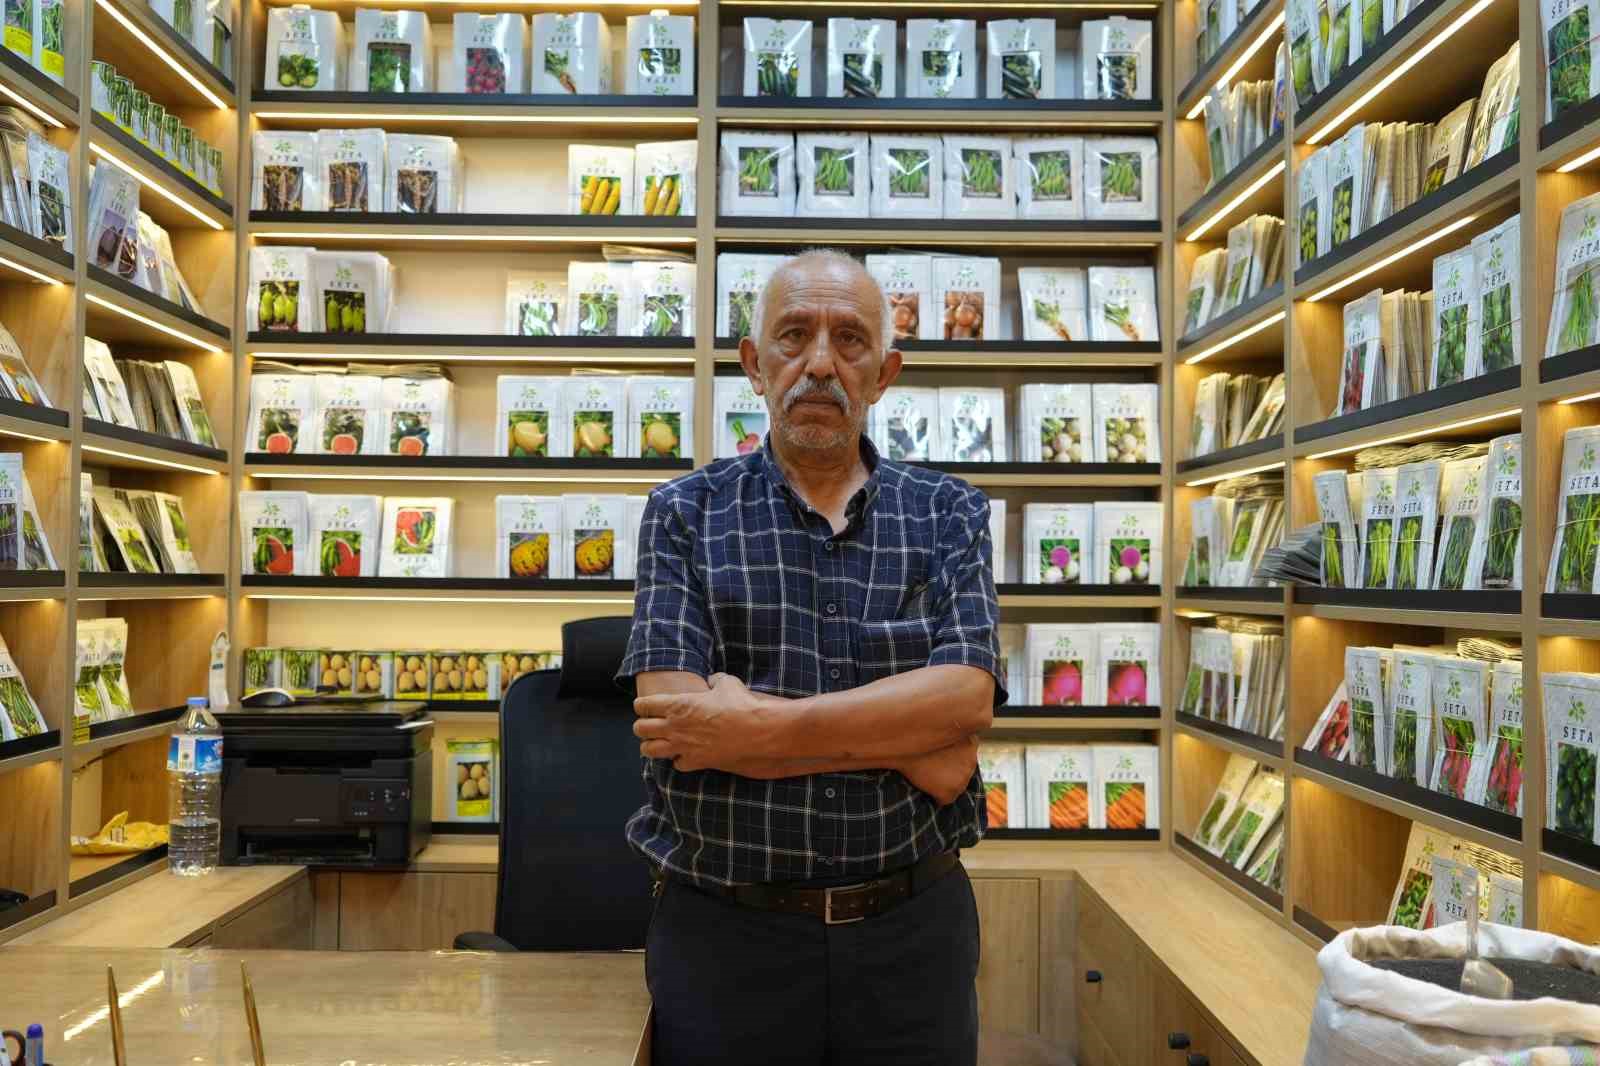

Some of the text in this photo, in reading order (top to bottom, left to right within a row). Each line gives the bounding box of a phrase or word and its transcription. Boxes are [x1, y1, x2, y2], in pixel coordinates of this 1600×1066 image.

[1484, 271, 1507, 289] SETA
[1441, 290, 1464, 307] SETA
[1570, 475, 1600, 491] SETA
[1371, 503, 1395, 516] SETA
[1402, 502, 1422, 514] SETA
[256, 518, 288, 526] SETA
[514, 522, 544, 530] SETA
[579, 519, 609, 527] SETA
[1115, 528, 1145, 537] SETA
[1048, 650, 1078, 658] SETA
[1113, 650, 1142, 658] SETA
[1351, 685, 1370, 698] SETA
[1442, 702, 1468, 717] SETA
[1502, 709, 1523, 722] SET
[1563, 726, 1594, 744] SETA
[1052, 771, 1083, 779] SETA
[1109, 772, 1140, 780] SETA
